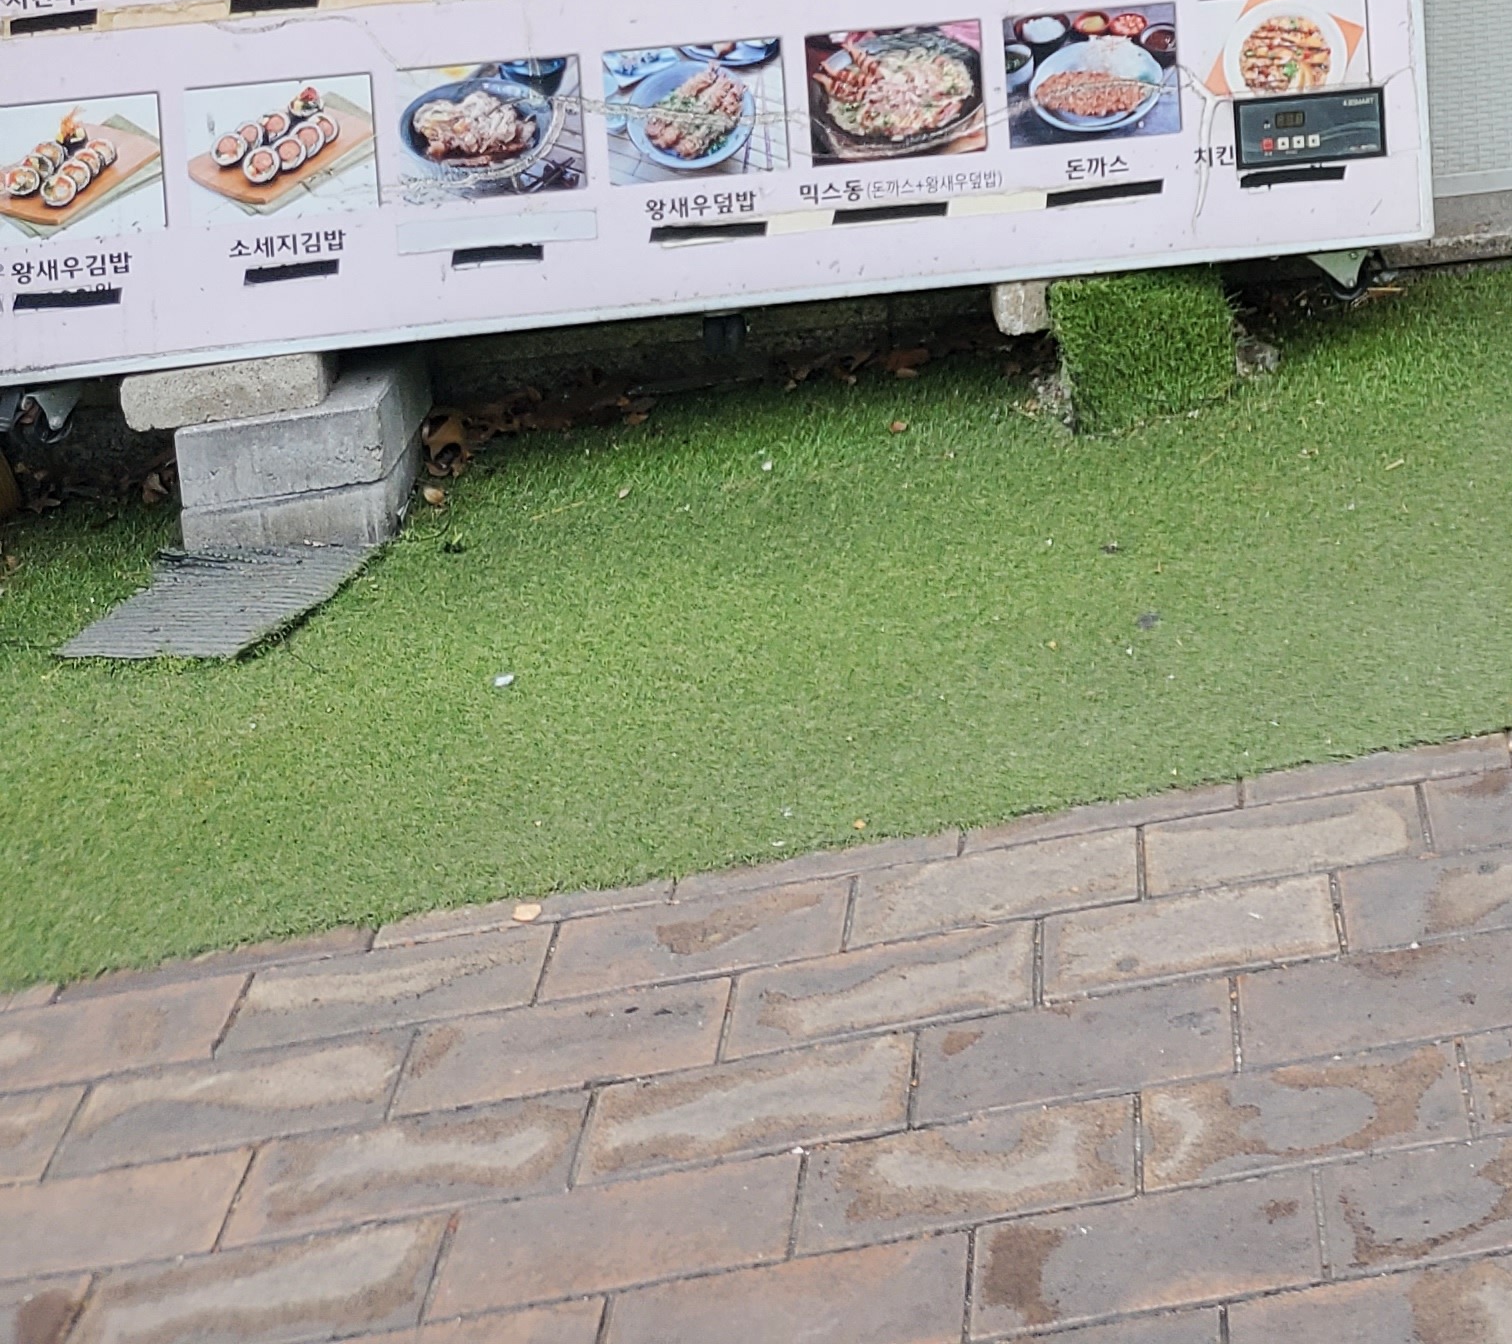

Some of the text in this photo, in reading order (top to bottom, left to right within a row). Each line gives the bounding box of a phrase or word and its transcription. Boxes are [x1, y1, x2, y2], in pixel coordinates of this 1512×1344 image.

[1064, 153, 1130, 179] 돈까스
[644, 188, 757, 221] 왕새우덮밥
[800, 179, 864, 205] 믹스동
[228, 229, 347, 259] 소세지김밥
[11, 251, 133, 285] 왕새우김밥
